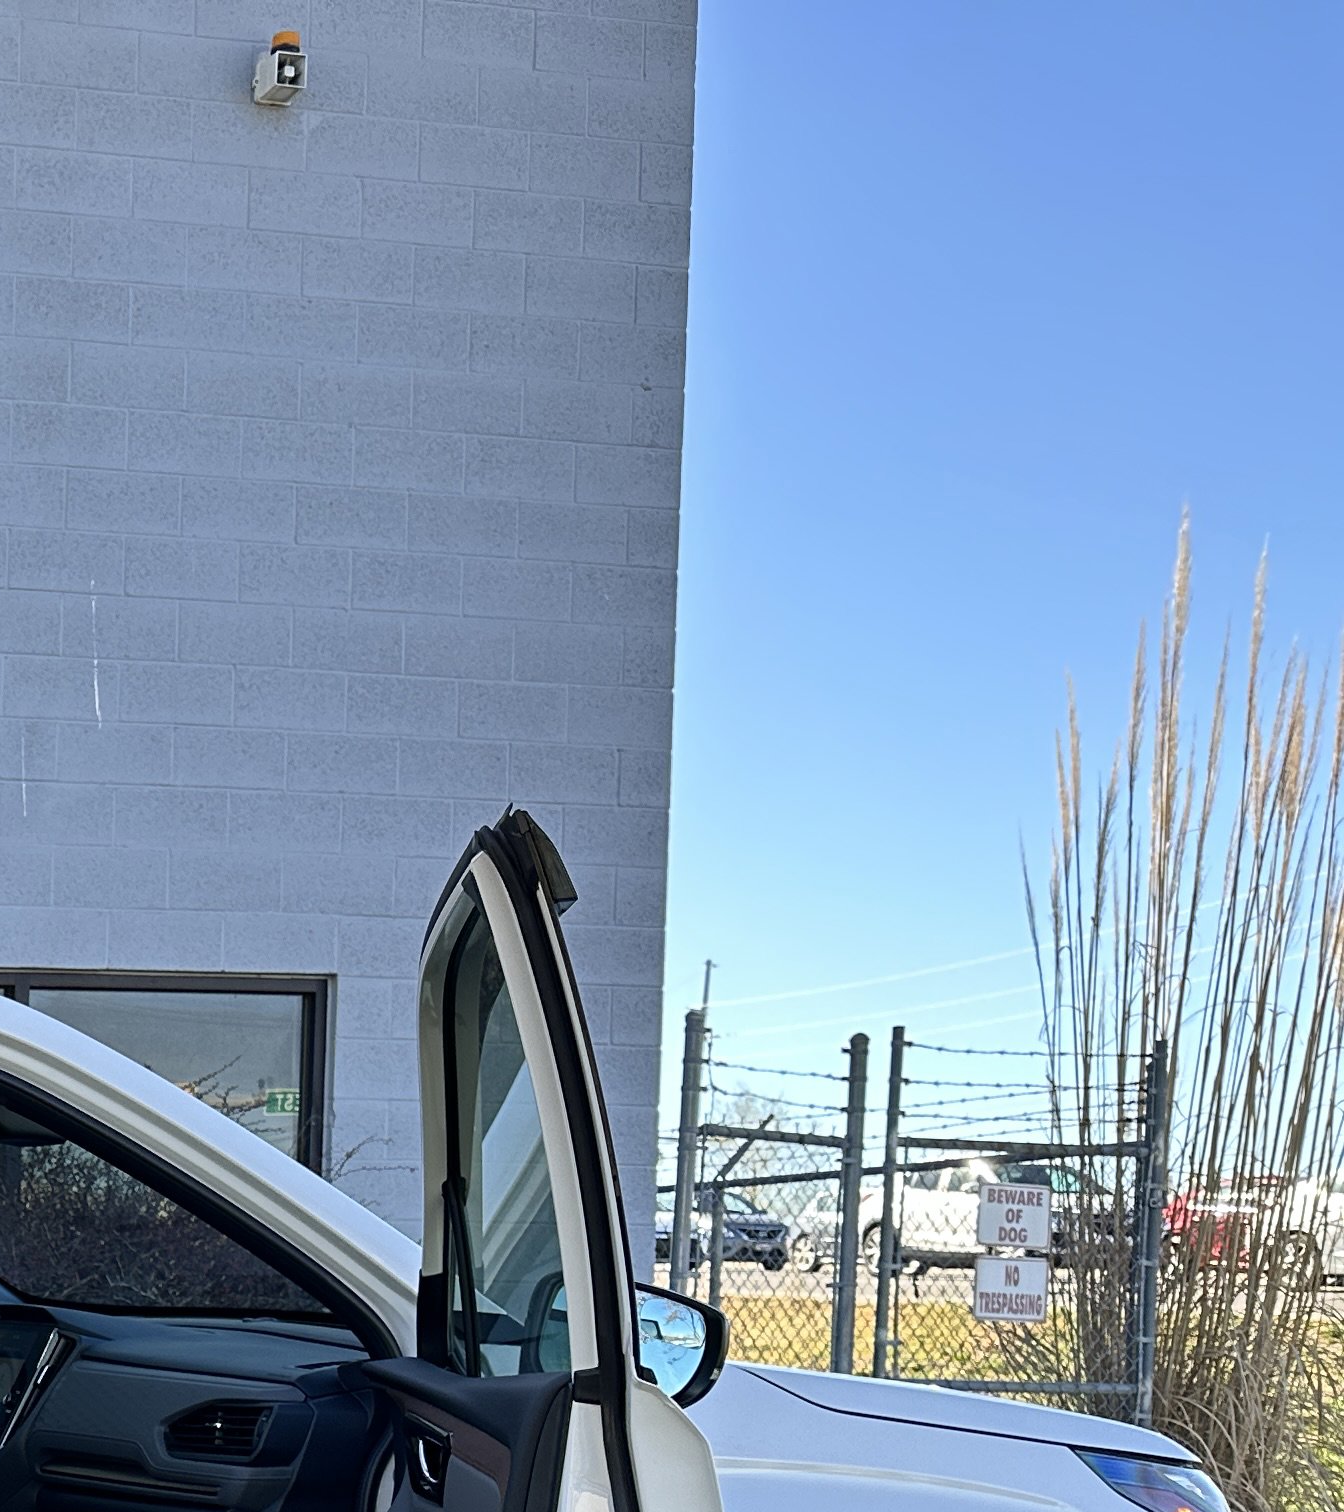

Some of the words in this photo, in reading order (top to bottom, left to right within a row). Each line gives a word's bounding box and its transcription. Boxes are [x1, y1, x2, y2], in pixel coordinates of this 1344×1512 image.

[987, 1188, 1044, 1207] BEWARE
[1005, 1209, 1023, 1224] OF
[998, 1227, 1028, 1243] DOG
[1004, 1265, 1020, 1287] NO
[979, 1291, 1043, 1316] TRESPASSING
